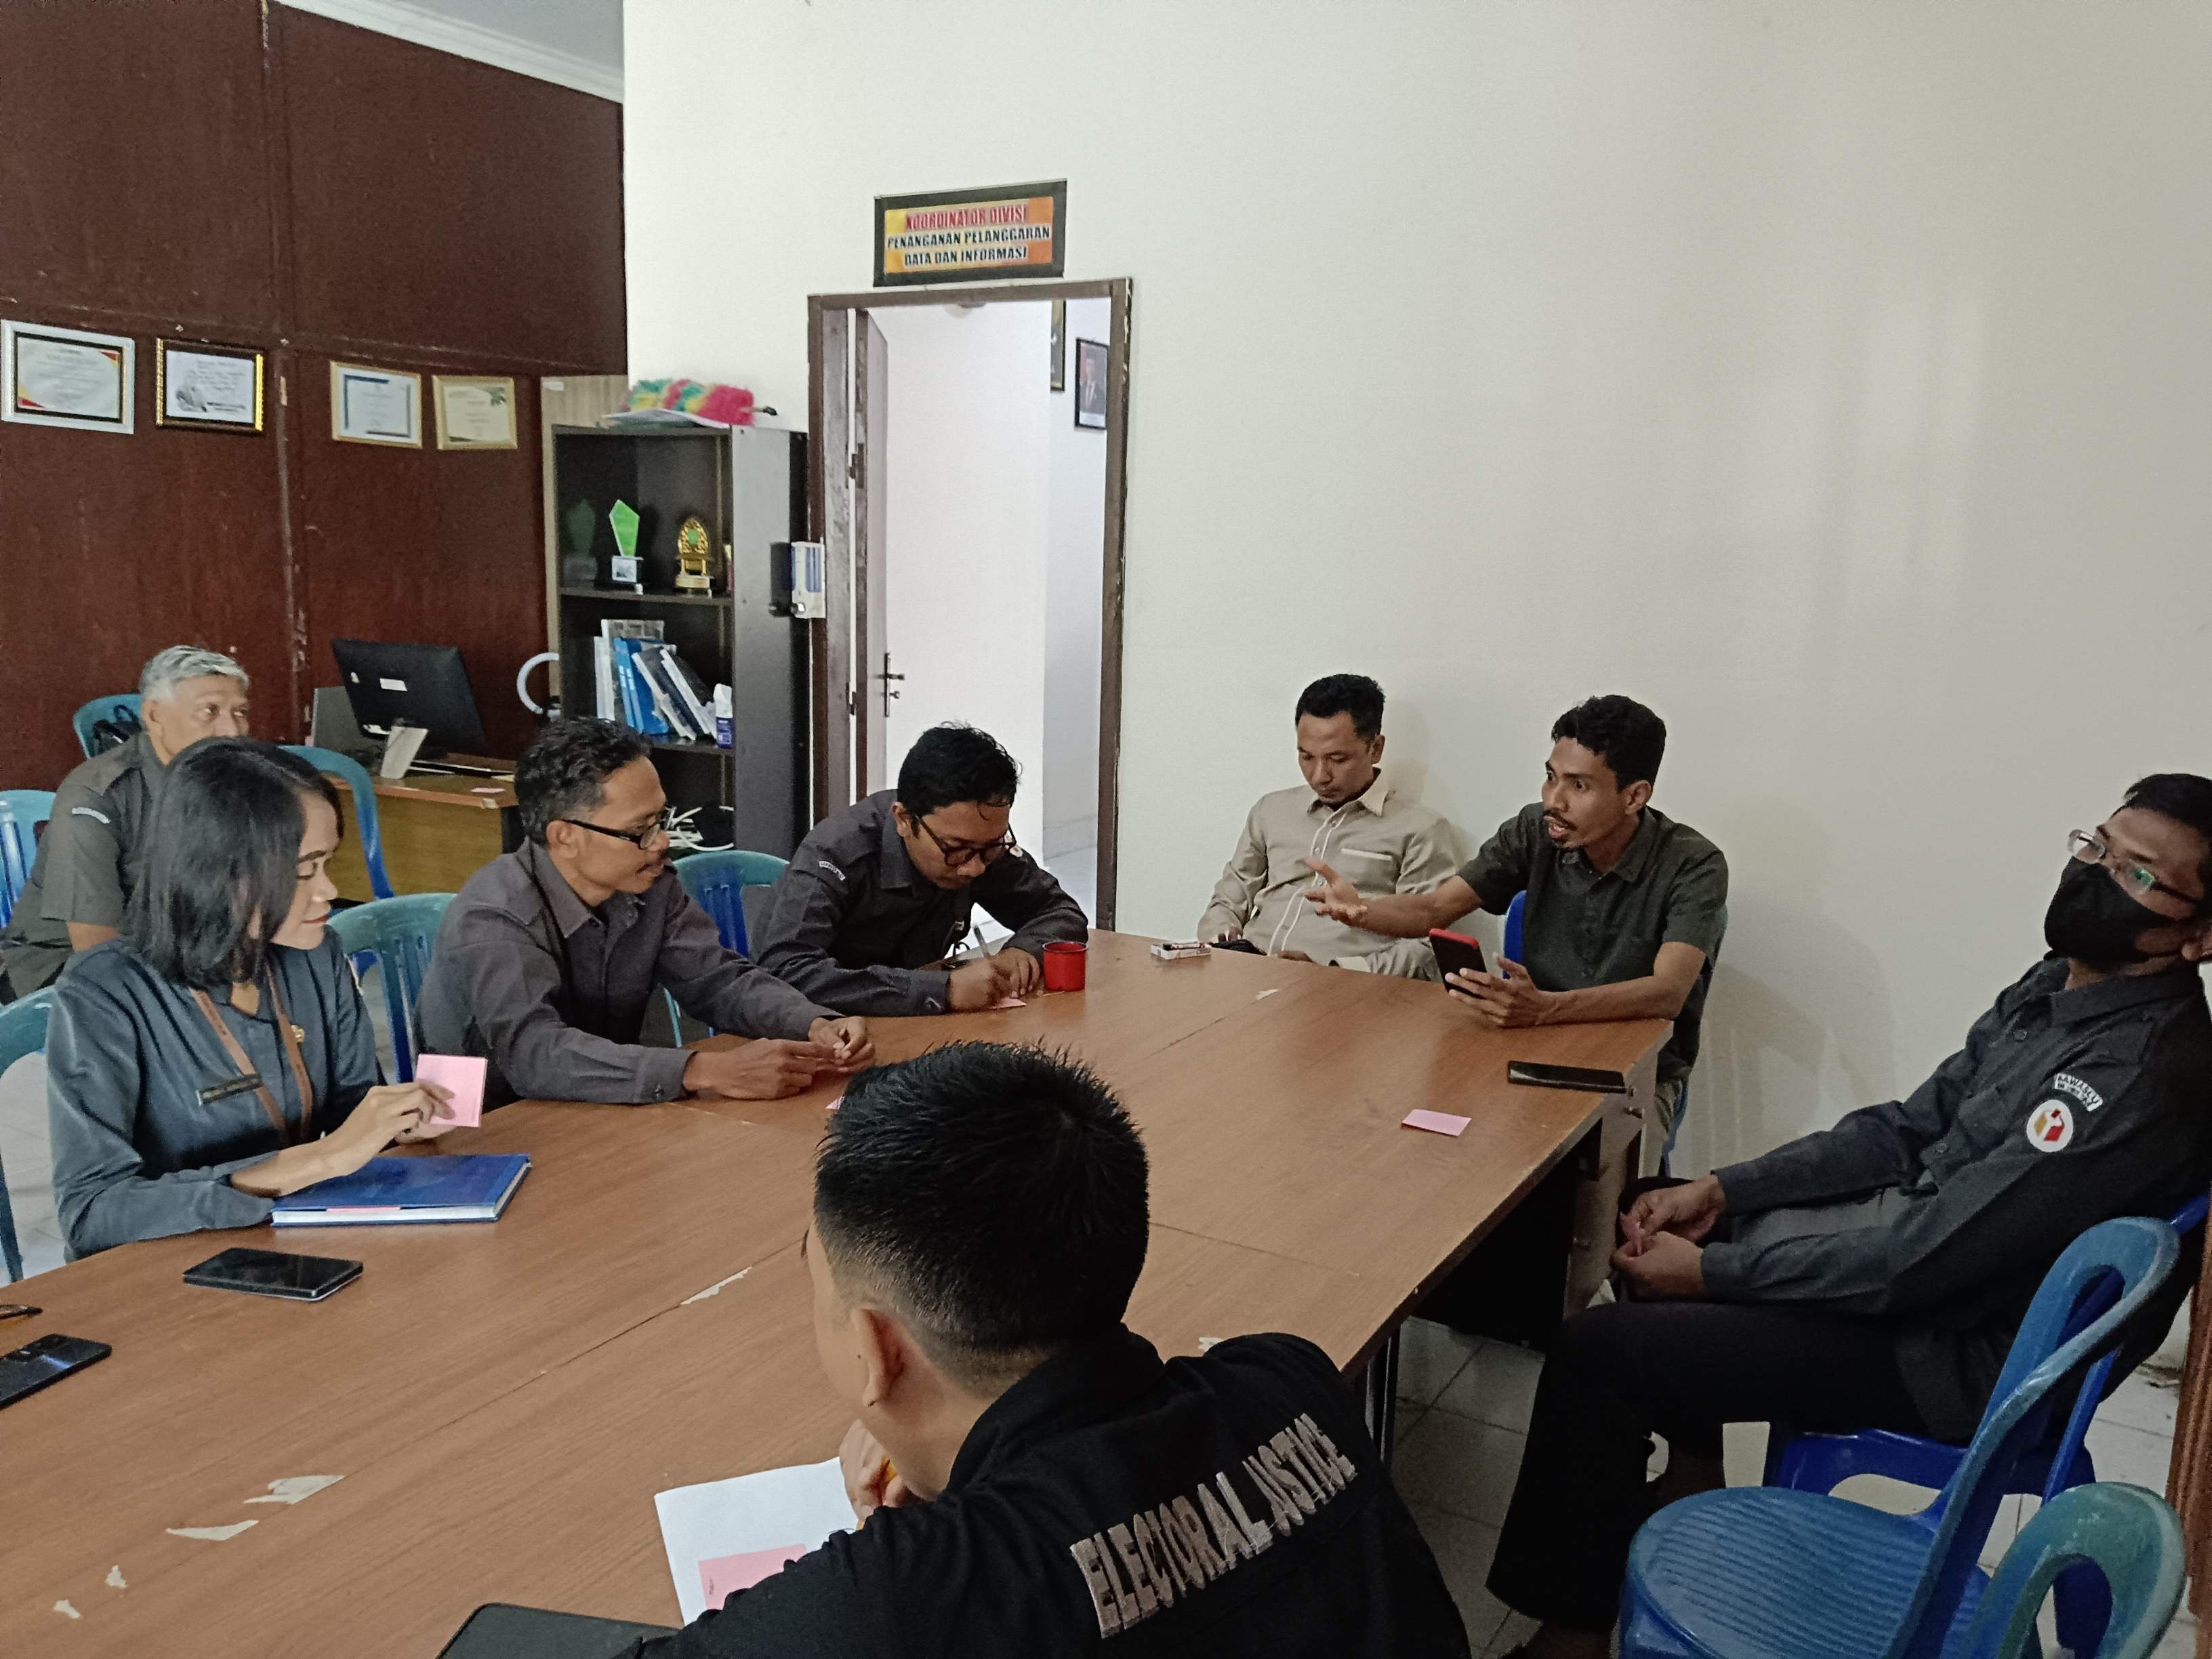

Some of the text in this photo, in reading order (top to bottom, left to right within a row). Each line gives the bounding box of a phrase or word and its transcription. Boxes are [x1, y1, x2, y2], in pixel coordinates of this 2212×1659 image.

[989, 205, 1027, 224] DIVISI
[887, 226, 1050, 248] PENANGANAN PELANGGARAN
[905, 246, 1027, 265] DATA DAN INFORMASI
